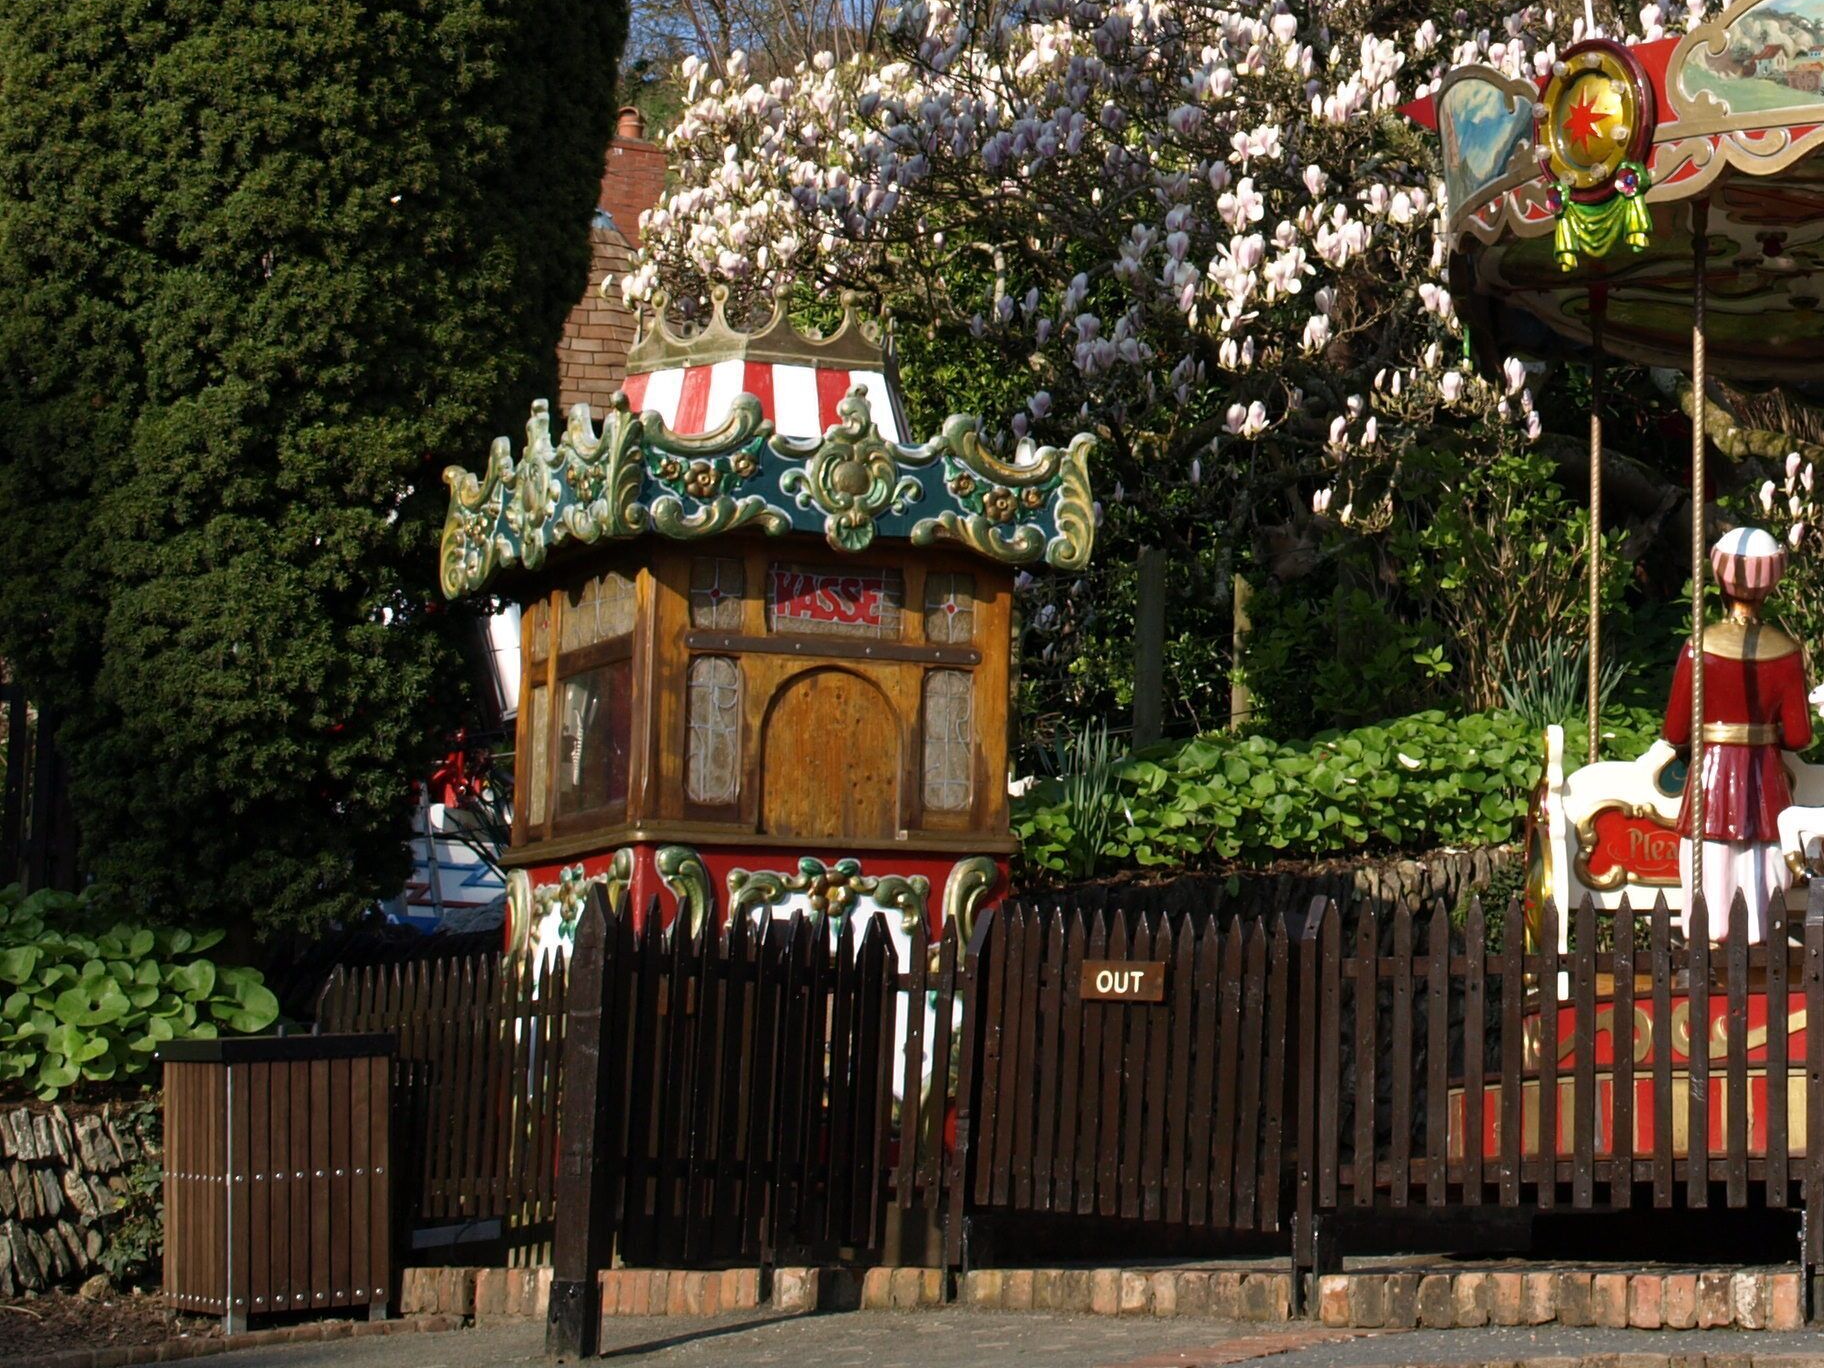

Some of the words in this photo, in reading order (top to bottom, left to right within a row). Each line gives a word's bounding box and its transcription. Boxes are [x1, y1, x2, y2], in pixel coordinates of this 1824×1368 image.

[774, 572, 884, 626] KASSE
[1626, 827, 1680, 862] Plea
[1096, 970, 1145, 994] OUT
